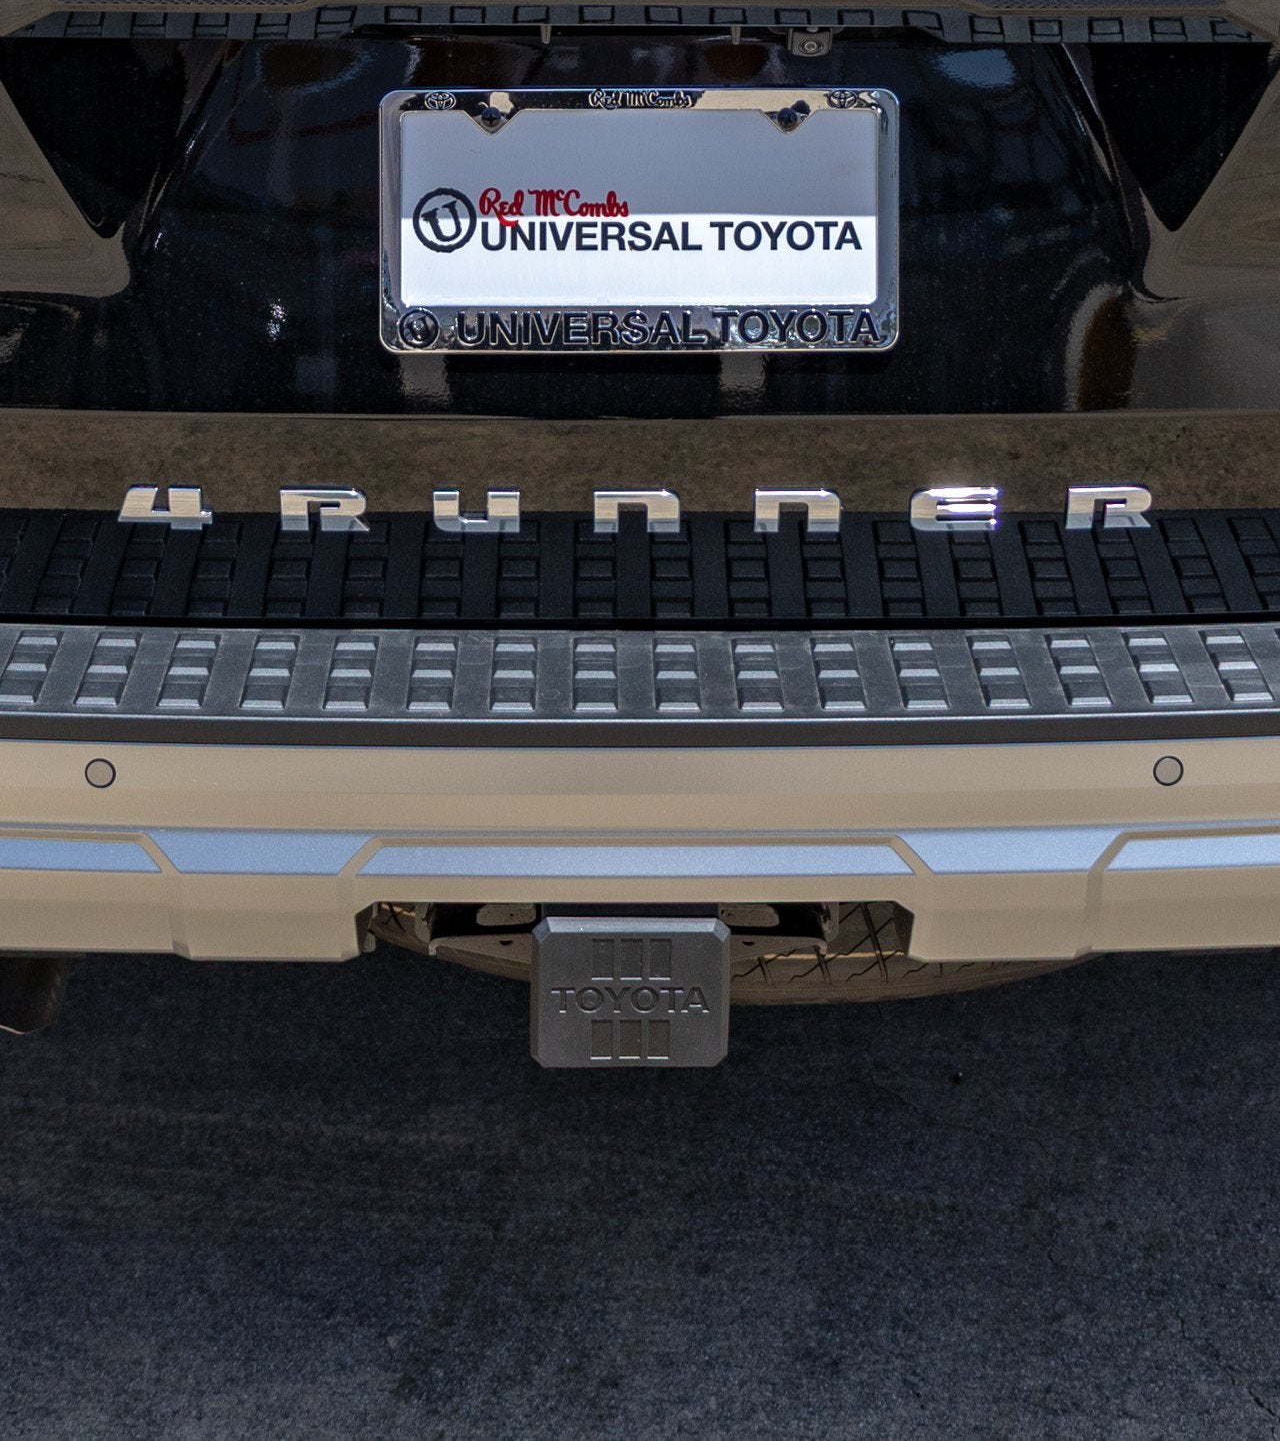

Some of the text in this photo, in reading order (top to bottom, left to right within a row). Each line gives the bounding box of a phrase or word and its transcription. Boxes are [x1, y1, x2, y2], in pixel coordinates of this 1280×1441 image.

[588, 89, 622, 110] Red
[479, 187, 629, 227] Red McCombs
[481, 220, 862, 252] UNIVERSAL TOYOTA
[456, 309, 881, 346] UNIVERSAL TOYOTA
[551, 986, 709, 1014] TOYOTA
